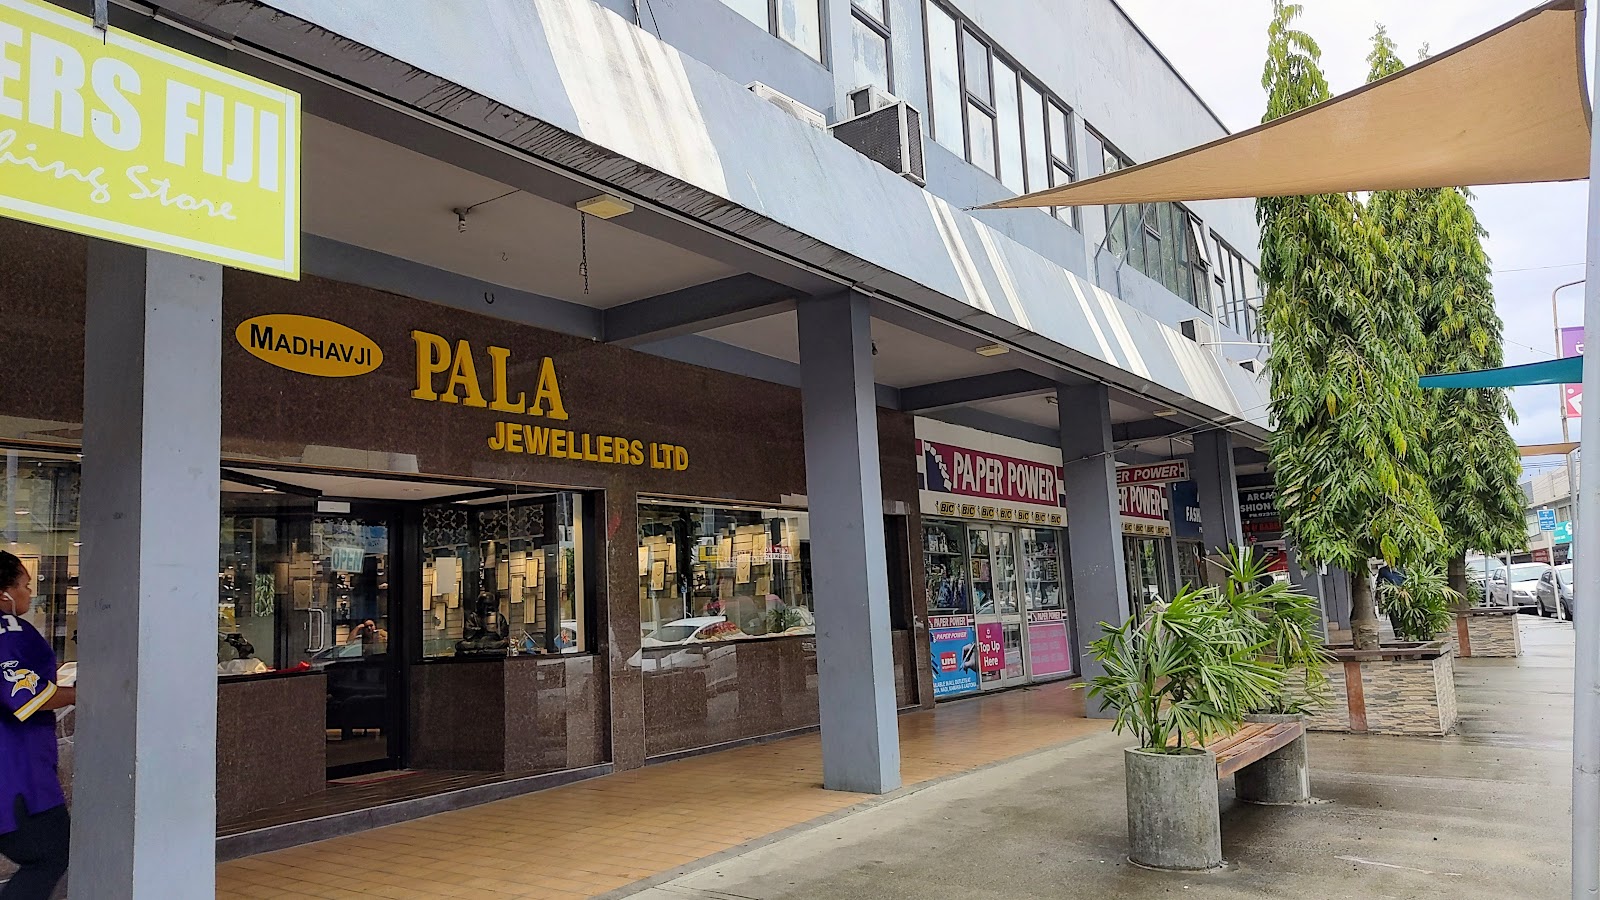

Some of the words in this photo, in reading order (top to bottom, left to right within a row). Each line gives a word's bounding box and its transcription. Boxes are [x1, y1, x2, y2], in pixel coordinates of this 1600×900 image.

[164, 79, 279, 192] FIJI
[125, 165, 237, 221] Store
[249, 323, 372, 367] MADHAVJI
[410, 329, 569, 421] PALA
[487, 421, 645, 466] JEWELLERS
[650, 441, 689, 471] LTD
[953, 451, 1004, 495] PAPER
[1007, 461, 1055, 502] POWER
[1134, 465, 1179, 481] POWER
[1129, 485, 1162, 517] POWER
[1247, 491, 1281, 502] ARCAD
[333, 548, 362, 571] OPEN
[933, 617, 948, 627] PAPER
[949, 616, 966, 626] POWER
[941, 653, 956, 666] uni
[980, 641, 990, 654] Top
[991, 640, 1001, 653] Up
[984, 656, 999, 668] Here
